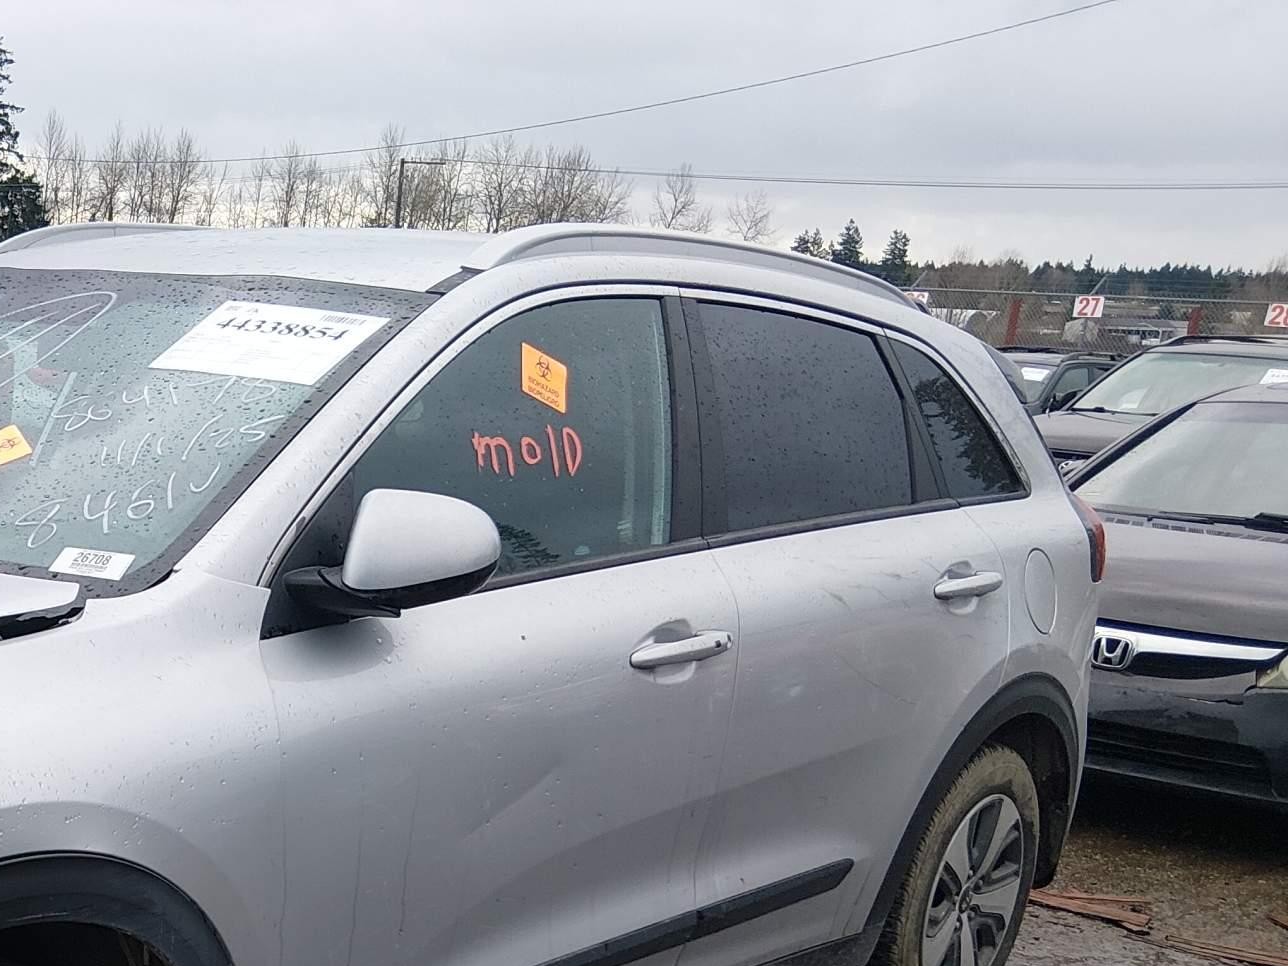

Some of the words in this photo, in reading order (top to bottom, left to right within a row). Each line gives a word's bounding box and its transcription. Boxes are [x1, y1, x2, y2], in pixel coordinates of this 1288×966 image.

[1077, 297, 1101, 317] 27
[216, 316, 350, 341] 44338854
[72, 551, 113, 567] 26708
